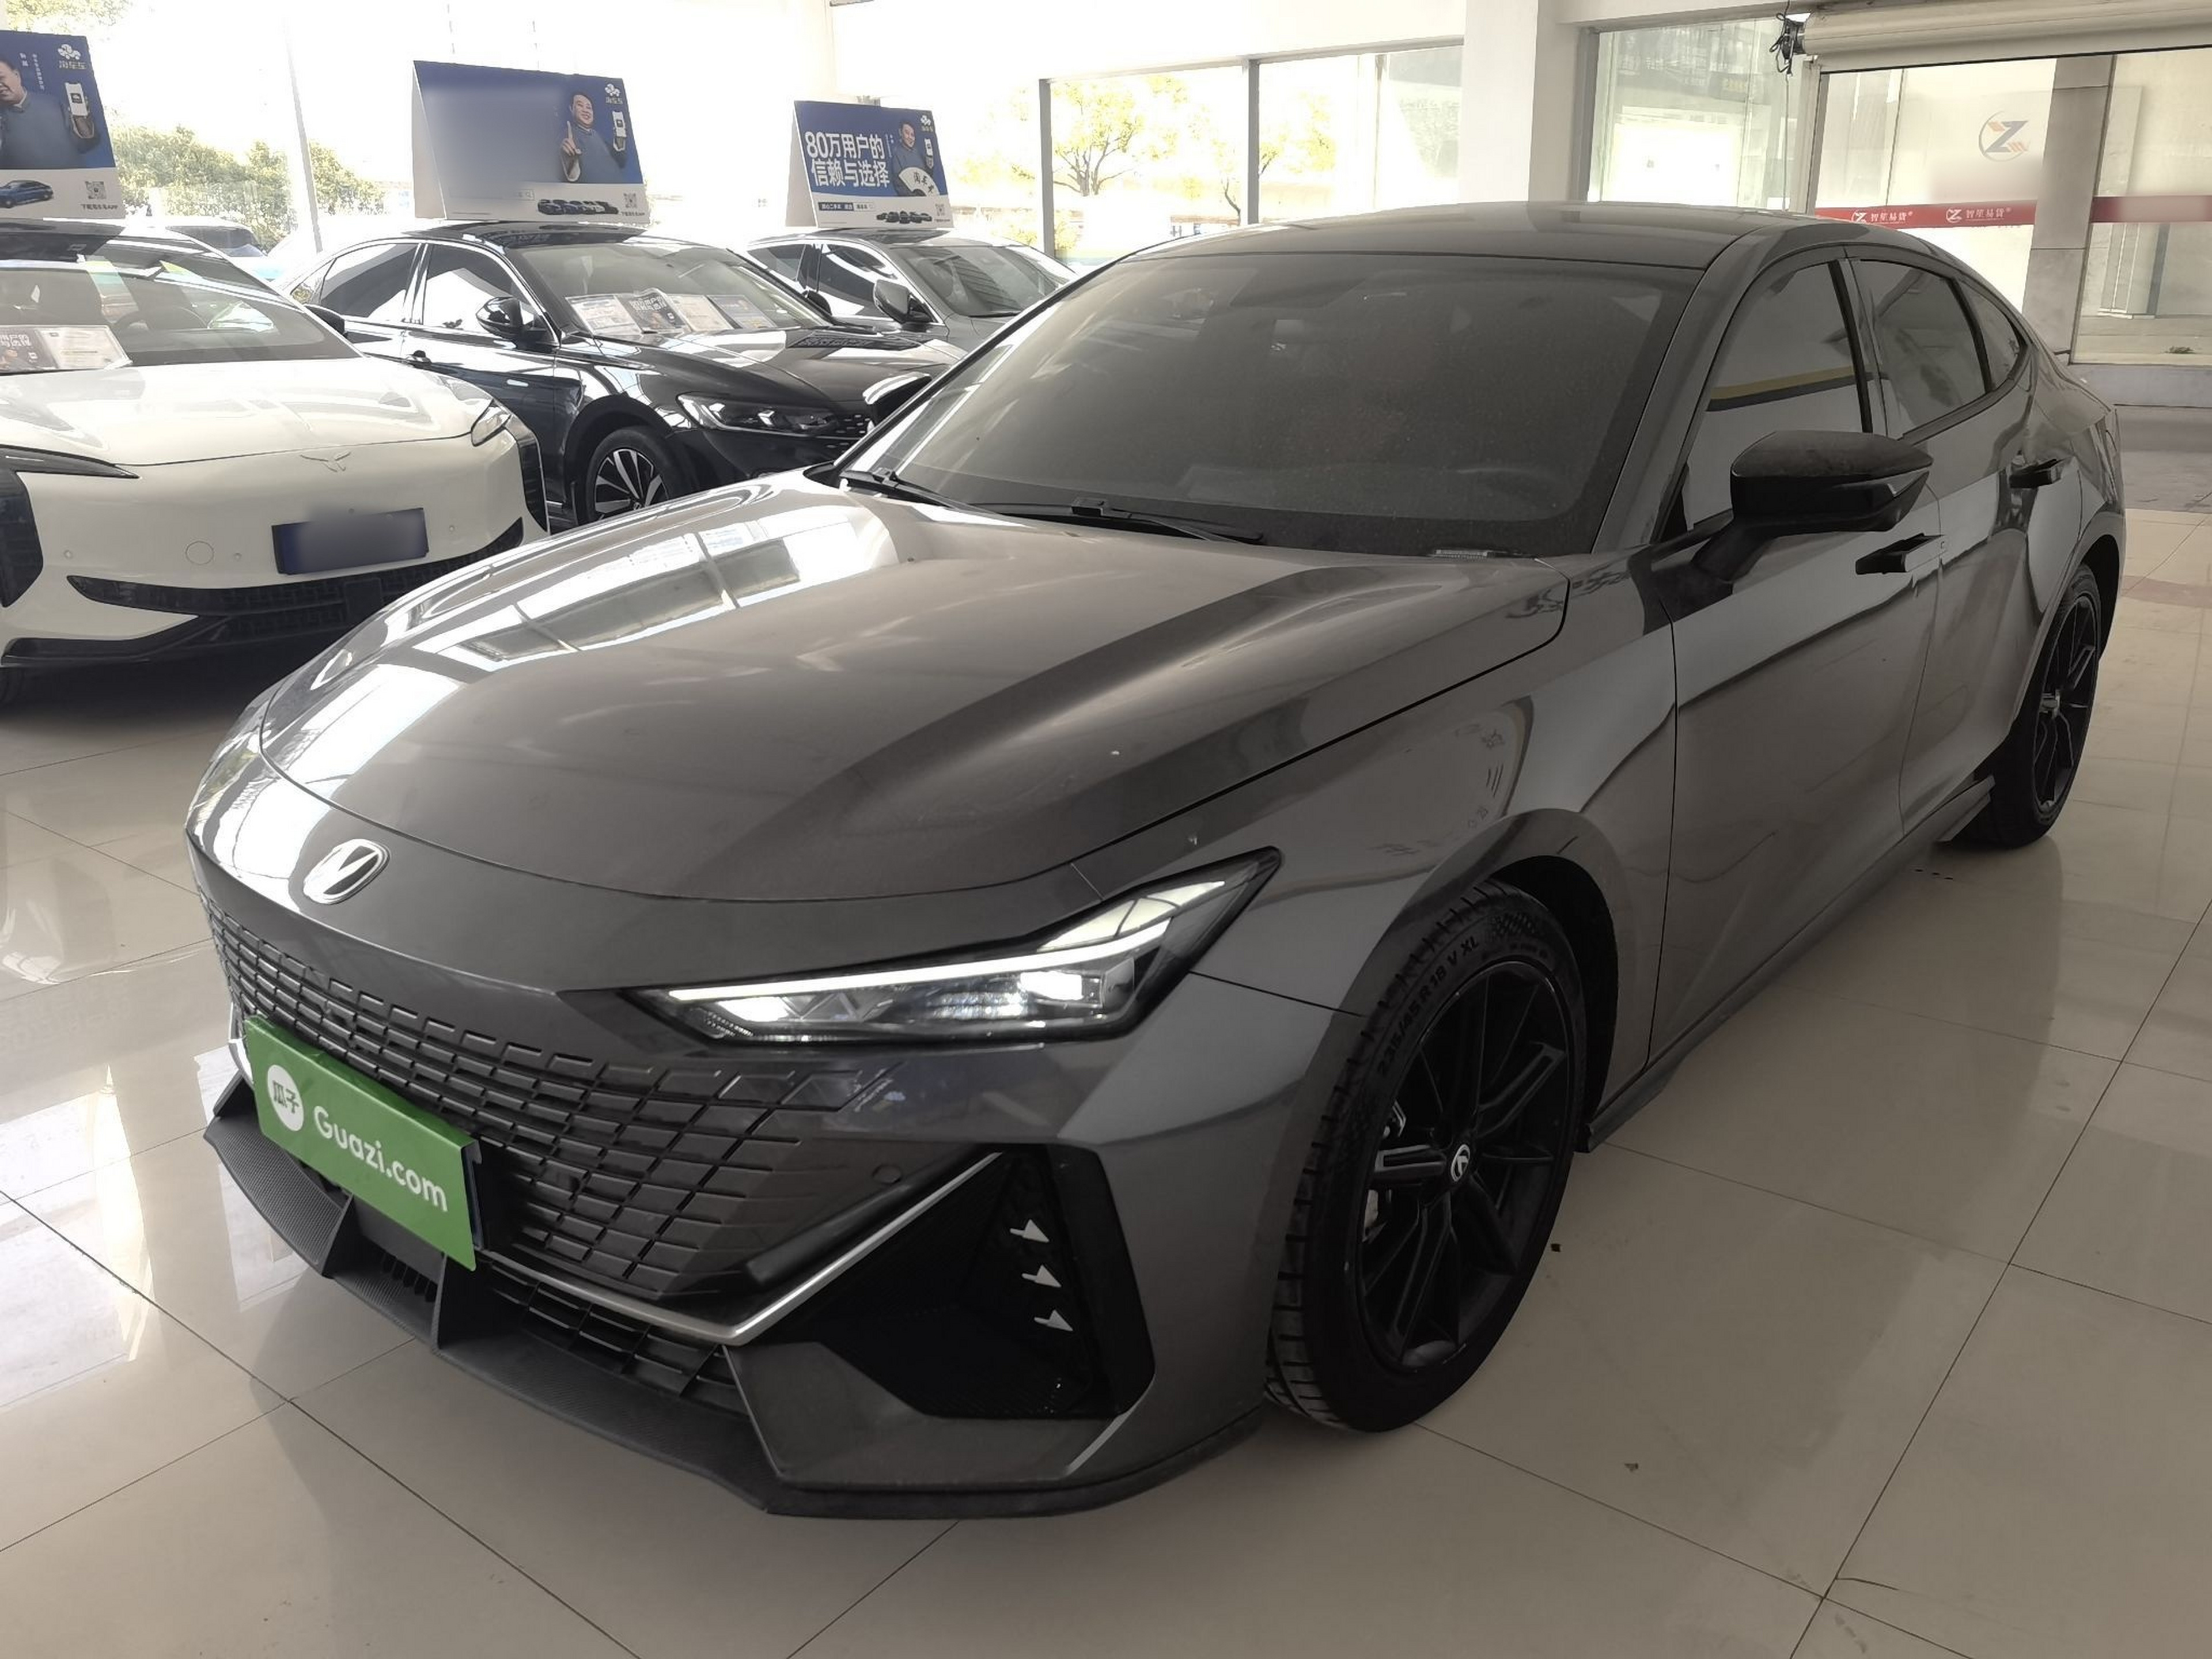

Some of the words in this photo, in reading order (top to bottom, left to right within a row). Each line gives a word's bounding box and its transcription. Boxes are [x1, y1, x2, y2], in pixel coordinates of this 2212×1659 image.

[805, 131, 885, 159] 80万用户的
[810, 157, 891, 188] 信赖与选择
[272, 1081, 300, 1114] 瓜子
[314, 1105, 448, 1212] Guazi.com
